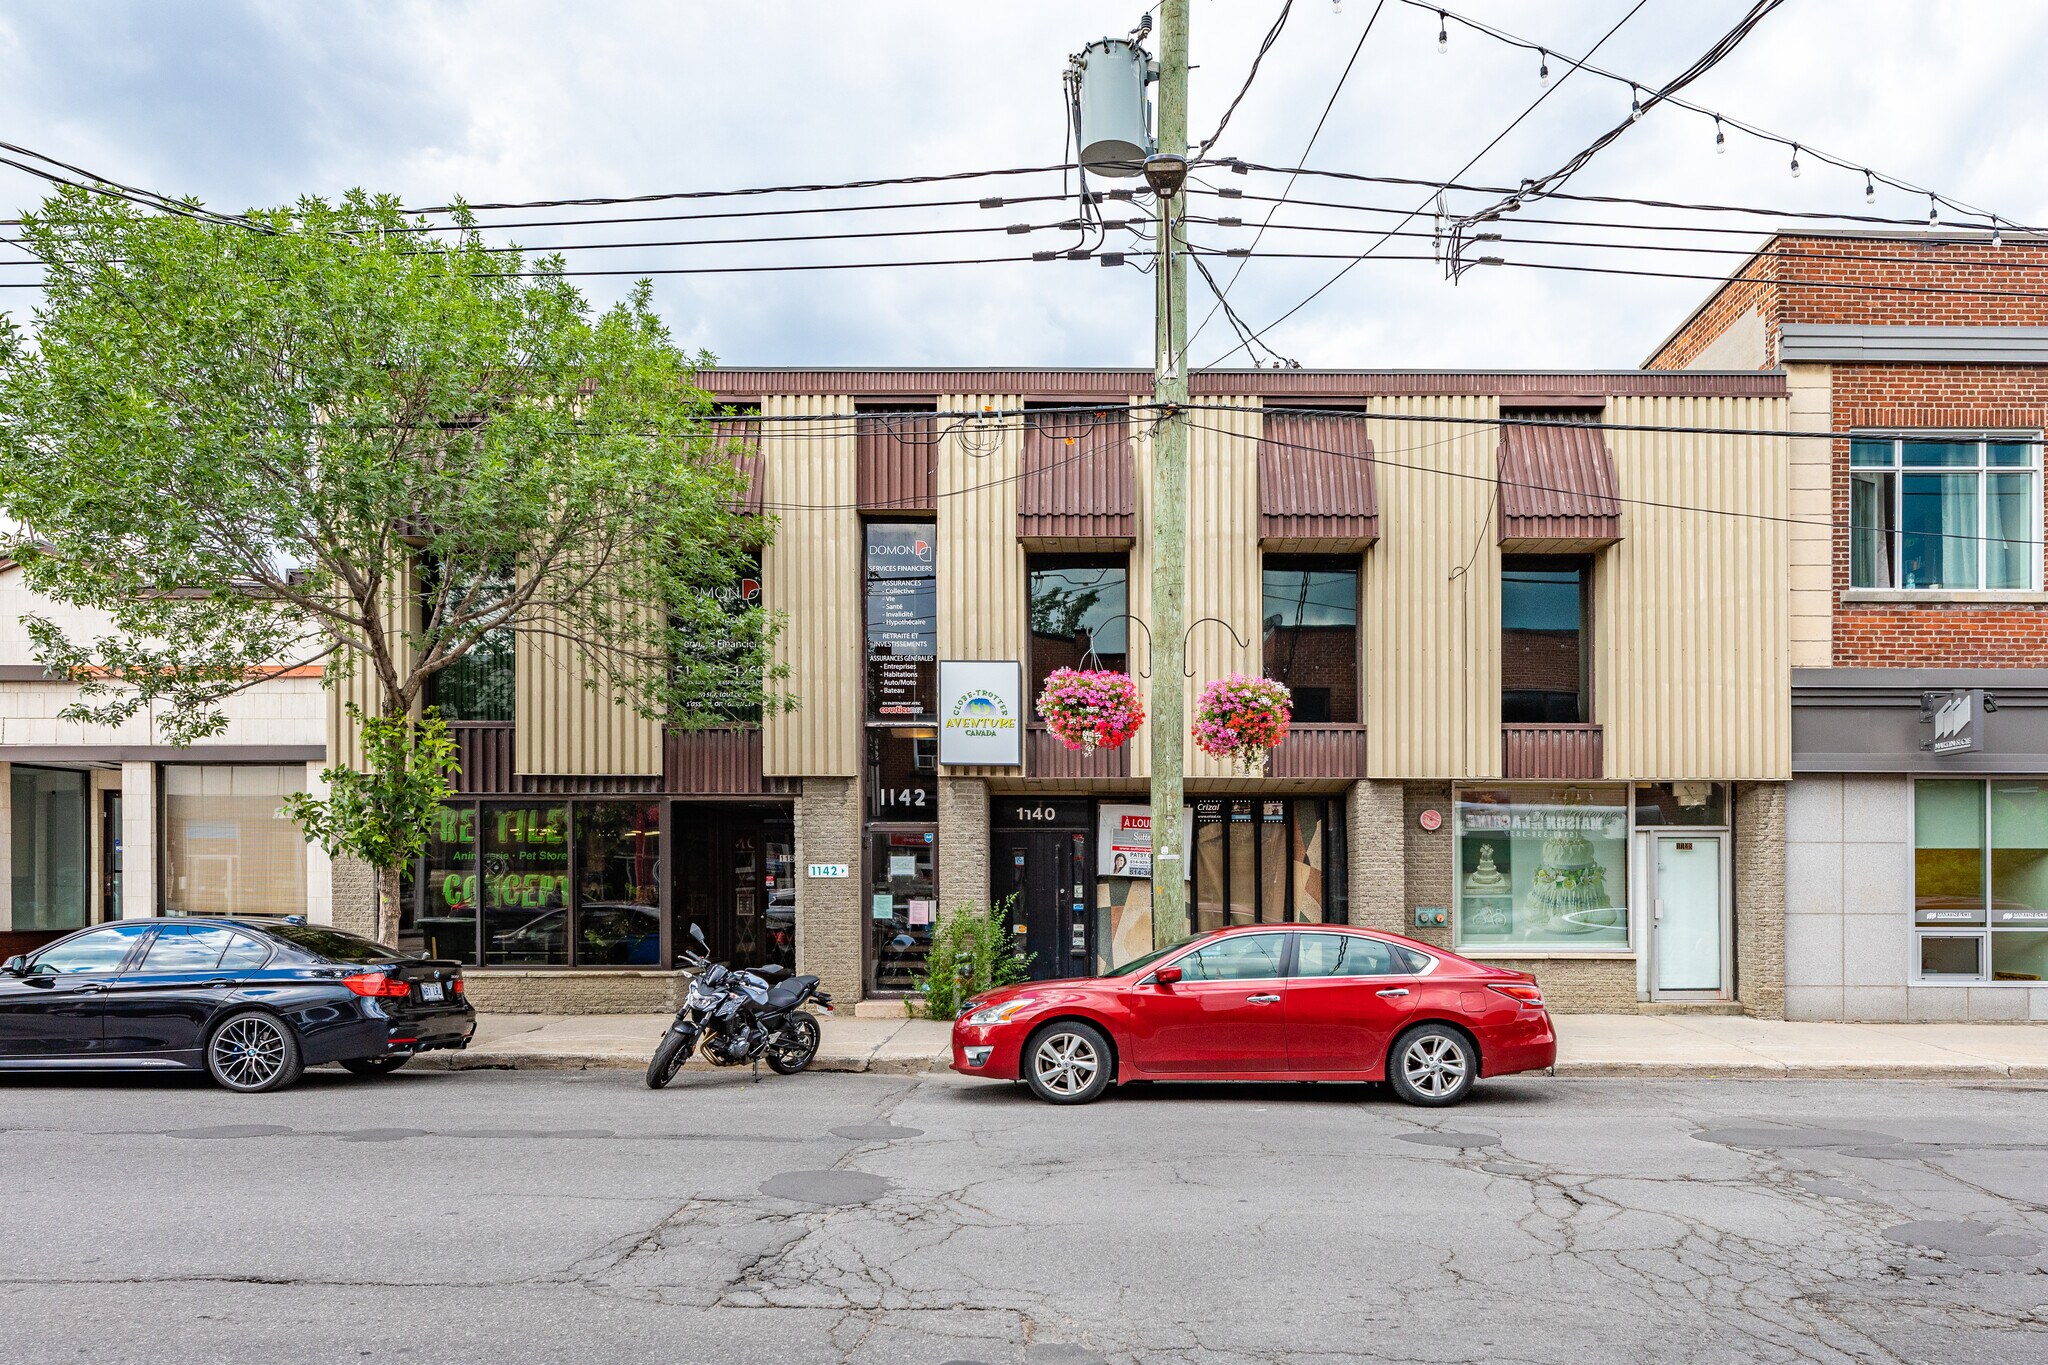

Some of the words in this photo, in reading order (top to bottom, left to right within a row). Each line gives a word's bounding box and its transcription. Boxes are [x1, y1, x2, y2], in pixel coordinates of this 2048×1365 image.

[869, 545, 914, 555] DOMON
[953, 689, 1009, 716] GLOBE-TROTTER
[945, 718, 1017, 729] AVENTURE
[965, 729, 997, 737] CANADA
[880, 788, 926, 806] 1142
[1197, 803, 1221, 811] Crizal
[1016, 807, 1056, 820] 1140
[440, 809, 583, 843] RETILE
[1124, 815, 1130, 827] À
[1132, 819, 1151, 828] LOU
[519, 851, 536, 861] Pet
[539, 851, 568, 861] Store
[811, 866, 837, 876] 1142
